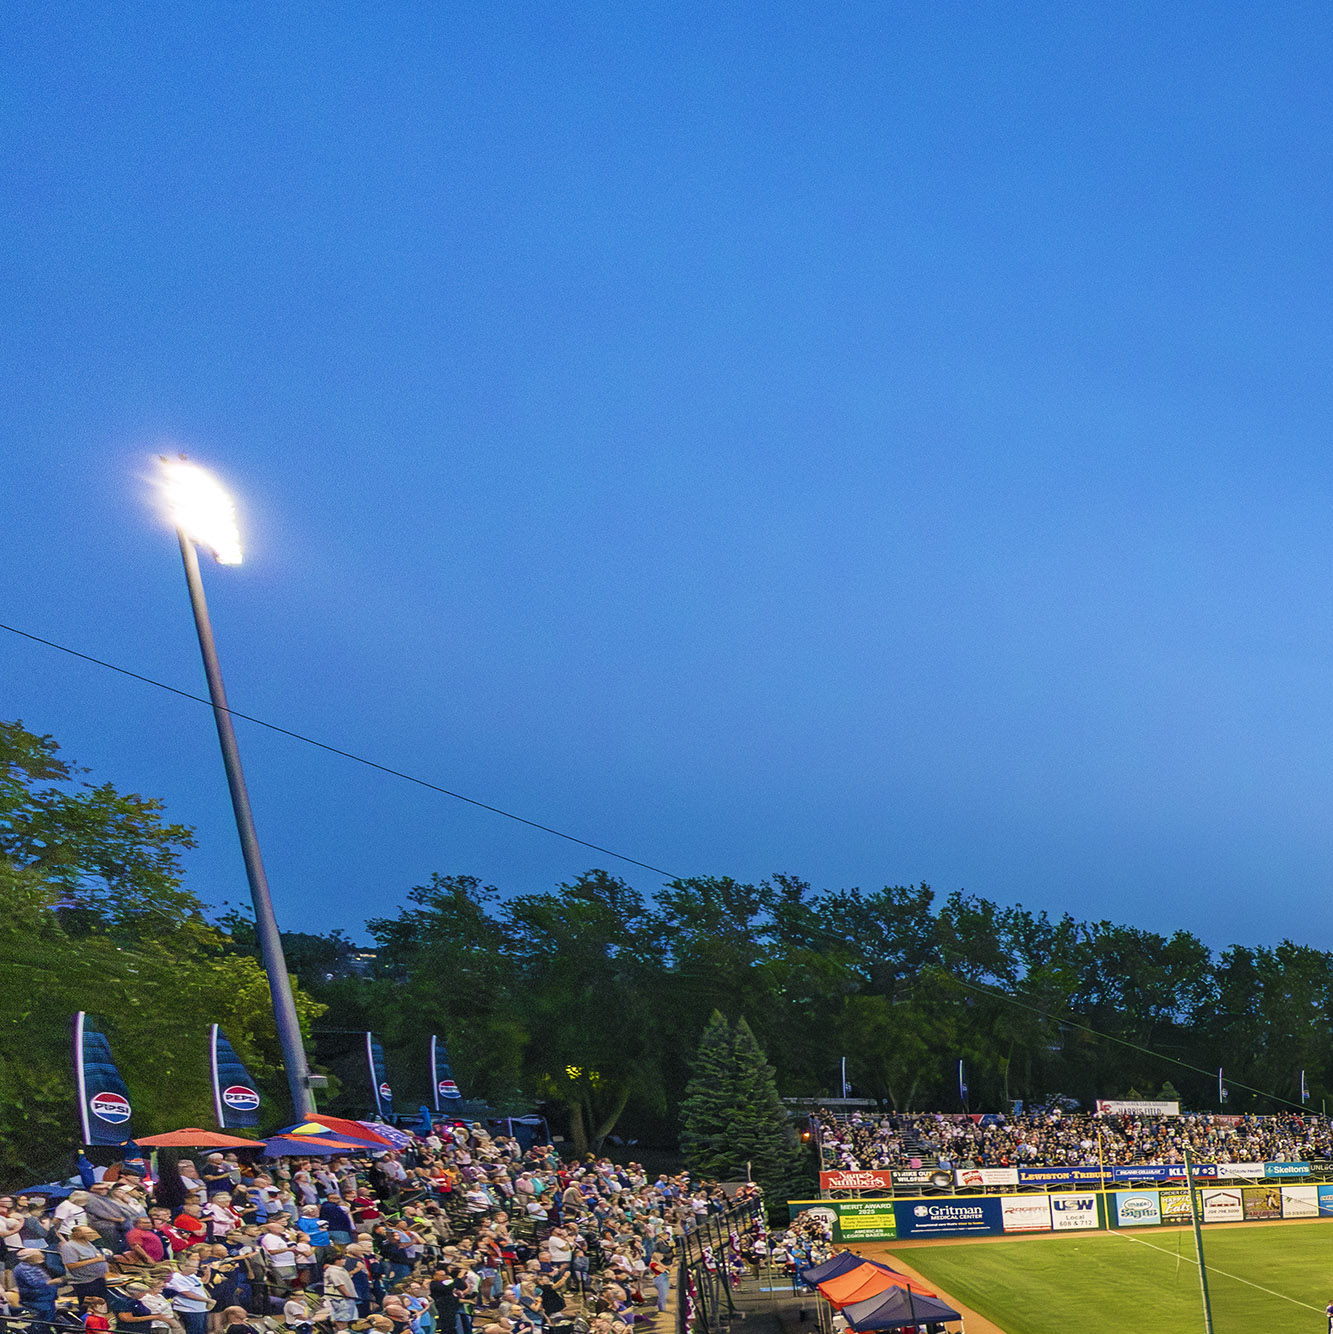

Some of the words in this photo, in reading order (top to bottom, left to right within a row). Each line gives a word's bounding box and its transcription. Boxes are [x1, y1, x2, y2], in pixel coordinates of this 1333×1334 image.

[225, 1093, 259, 1104] PEPSI
[93, 1101, 130, 1114] PEPSI
[1274, 1166, 1309, 1174] Skelton's
[1053, 1199, 1094, 1210] USW
[929, 1206, 983, 1216] Gritman
